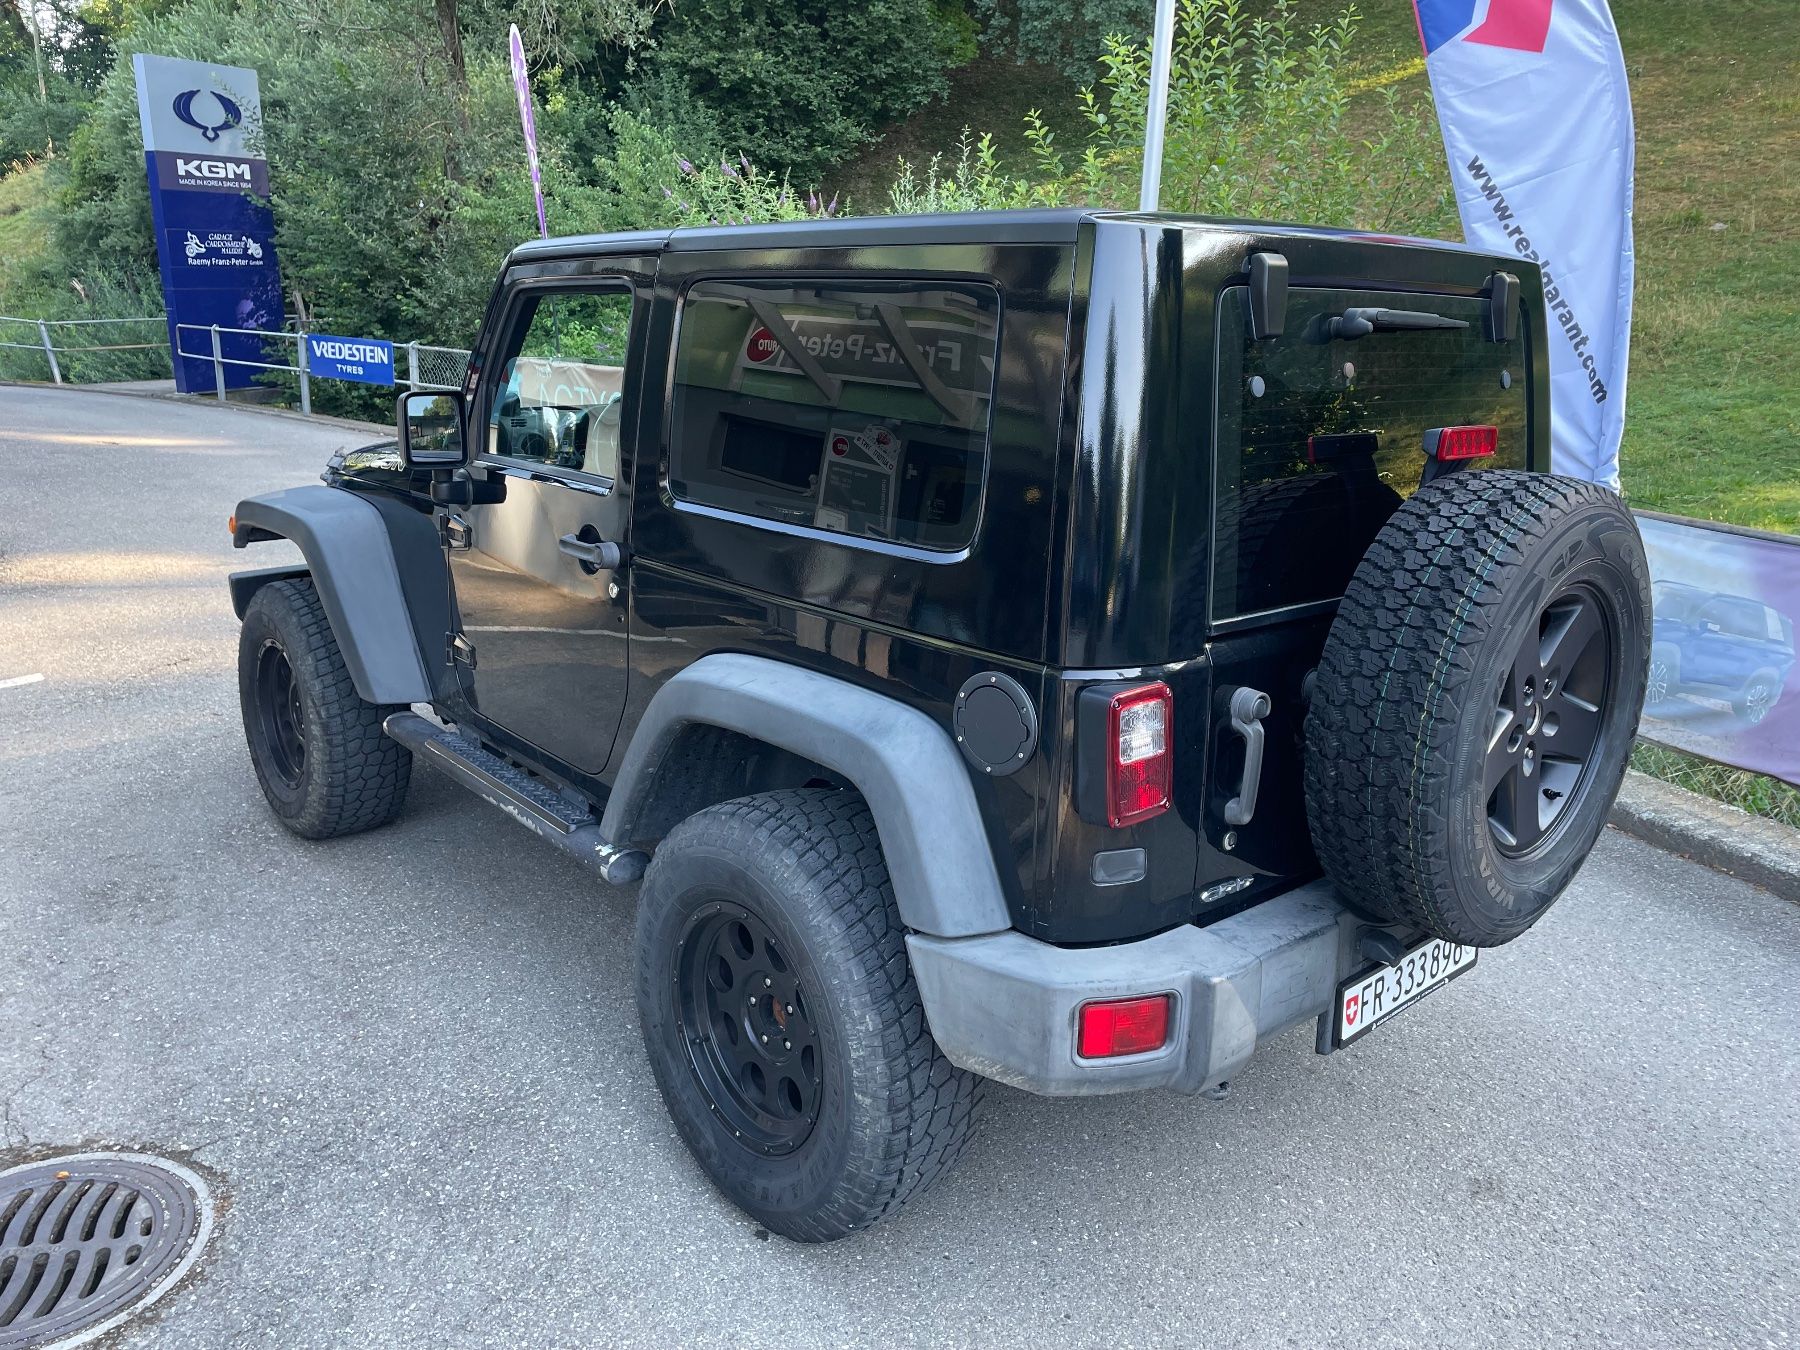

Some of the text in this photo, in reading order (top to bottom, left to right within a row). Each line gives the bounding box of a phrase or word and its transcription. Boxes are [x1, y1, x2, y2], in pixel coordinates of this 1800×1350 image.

[176, 159, 251, 180] KGM
[208, 233, 233, 241] GARAGE
[187, 257, 211, 267] Raemy
[211, 257, 249, 266] Franz-Peter
[311, 340, 389, 365] VREDESTEIN
[336, 363, 364, 375] TYRES
